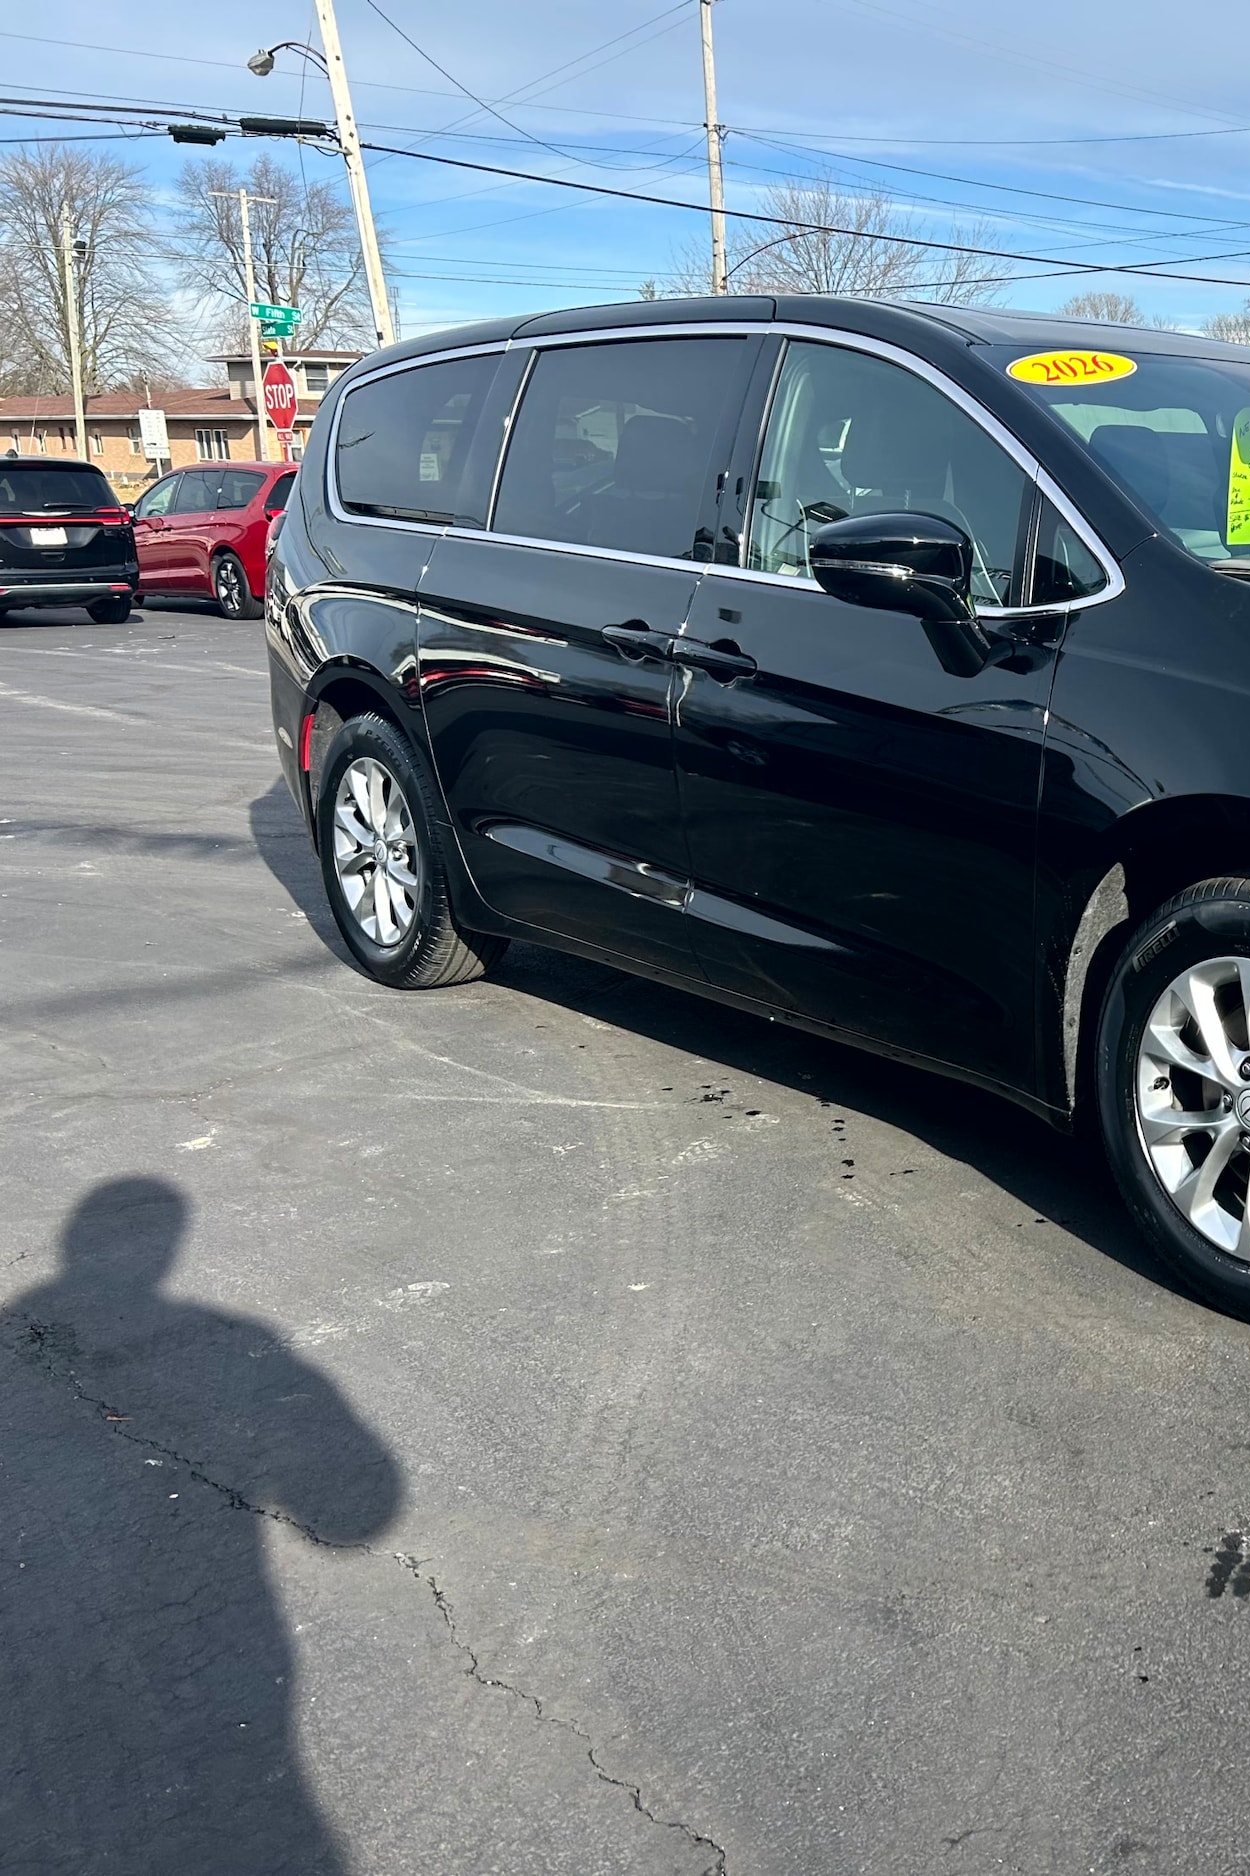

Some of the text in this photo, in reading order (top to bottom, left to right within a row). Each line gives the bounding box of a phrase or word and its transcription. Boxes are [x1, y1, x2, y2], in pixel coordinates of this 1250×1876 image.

[251, 306, 301, 321] W Fifth St
[1031, 355, 1114, 382] 2026
[265, 384, 294, 410] STOP
[1132, 919, 1180, 972] PIRELLI
